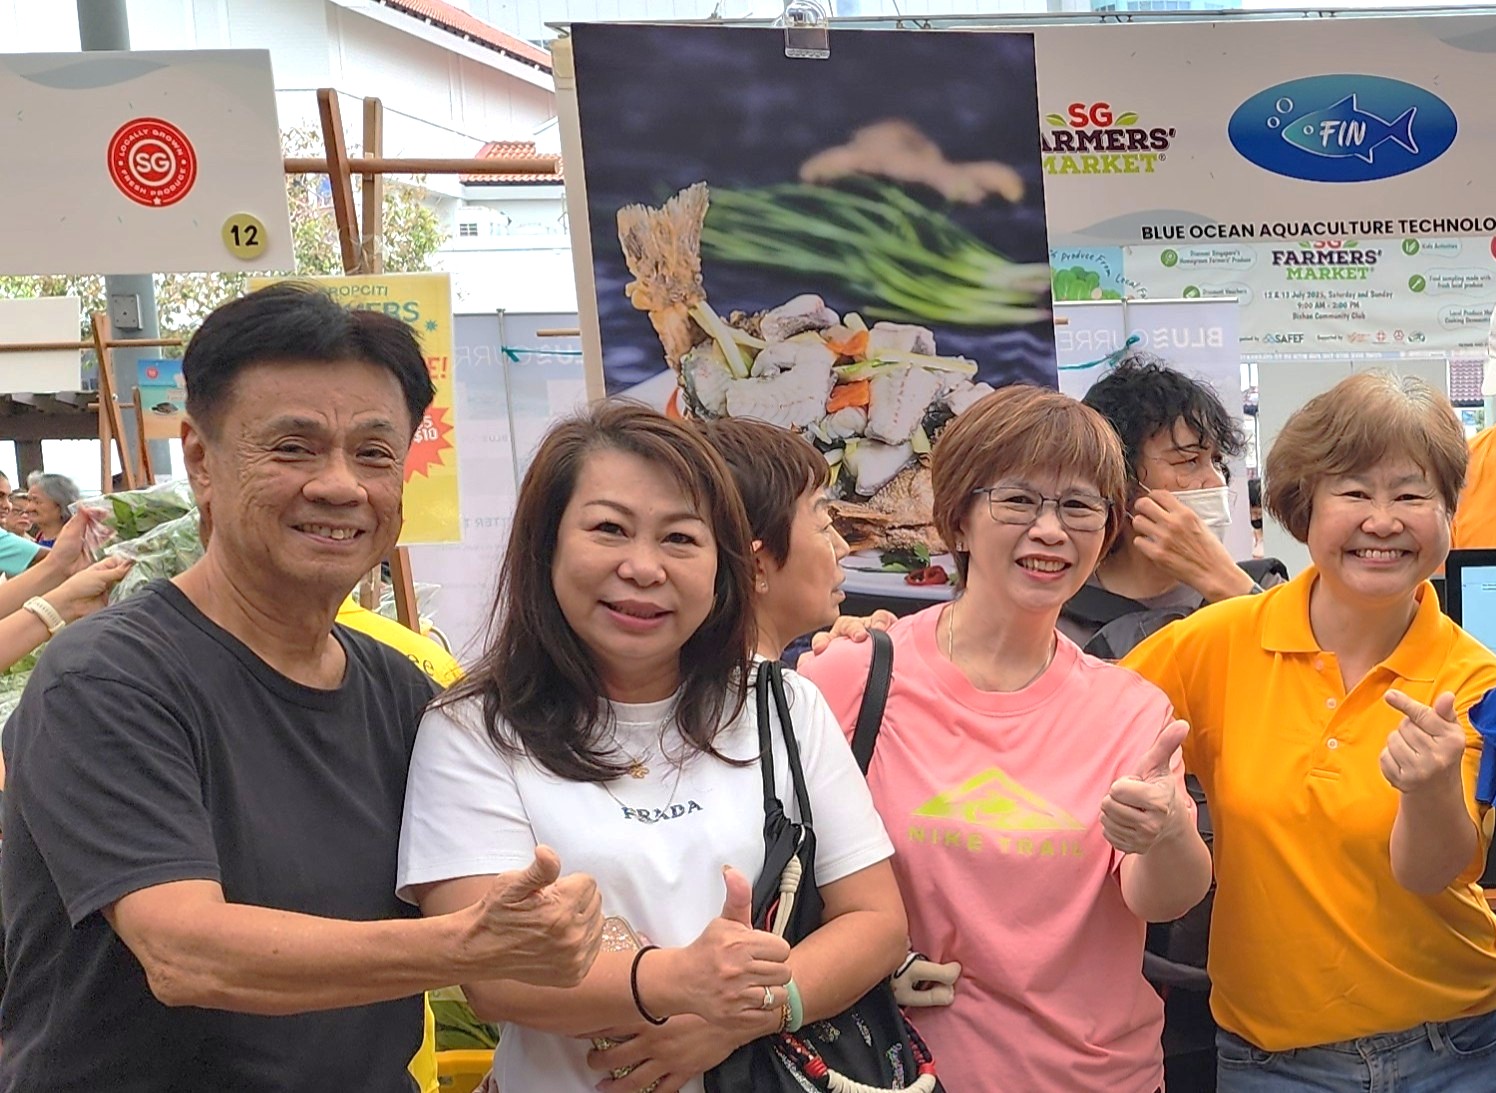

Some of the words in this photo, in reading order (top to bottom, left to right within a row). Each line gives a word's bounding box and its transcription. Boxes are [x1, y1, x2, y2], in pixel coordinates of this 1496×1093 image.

[1068, 102, 1113, 128] SG
[119, 129, 150, 157] LOCALLY
[152, 129, 184, 156] GROWN
[1320, 119, 1366, 147] FIN
[136, 152, 170, 173] SG
[121, 169, 147, 195] FRESH
[150, 168, 187, 196] PRODUCE
[230, 224, 259, 246] 12
[1141, 225, 1186, 240] BLUE
[1189, 223, 1255, 239] OCEAN
[1259, 220, 1394, 238] AQUACULTURE
[1272, 249, 1382, 265] FARMERS'
[1291, 291, 1305, 300] July
[1315, 312, 1350, 321] Community
[1351, 312, 1366, 320] Club
[1275, 333, 1304, 344] SAFEF
[621, 800, 703, 822] PRADA
[908, 826, 983, 852] NIKE
[998, 837, 1084, 858] TRAIL
